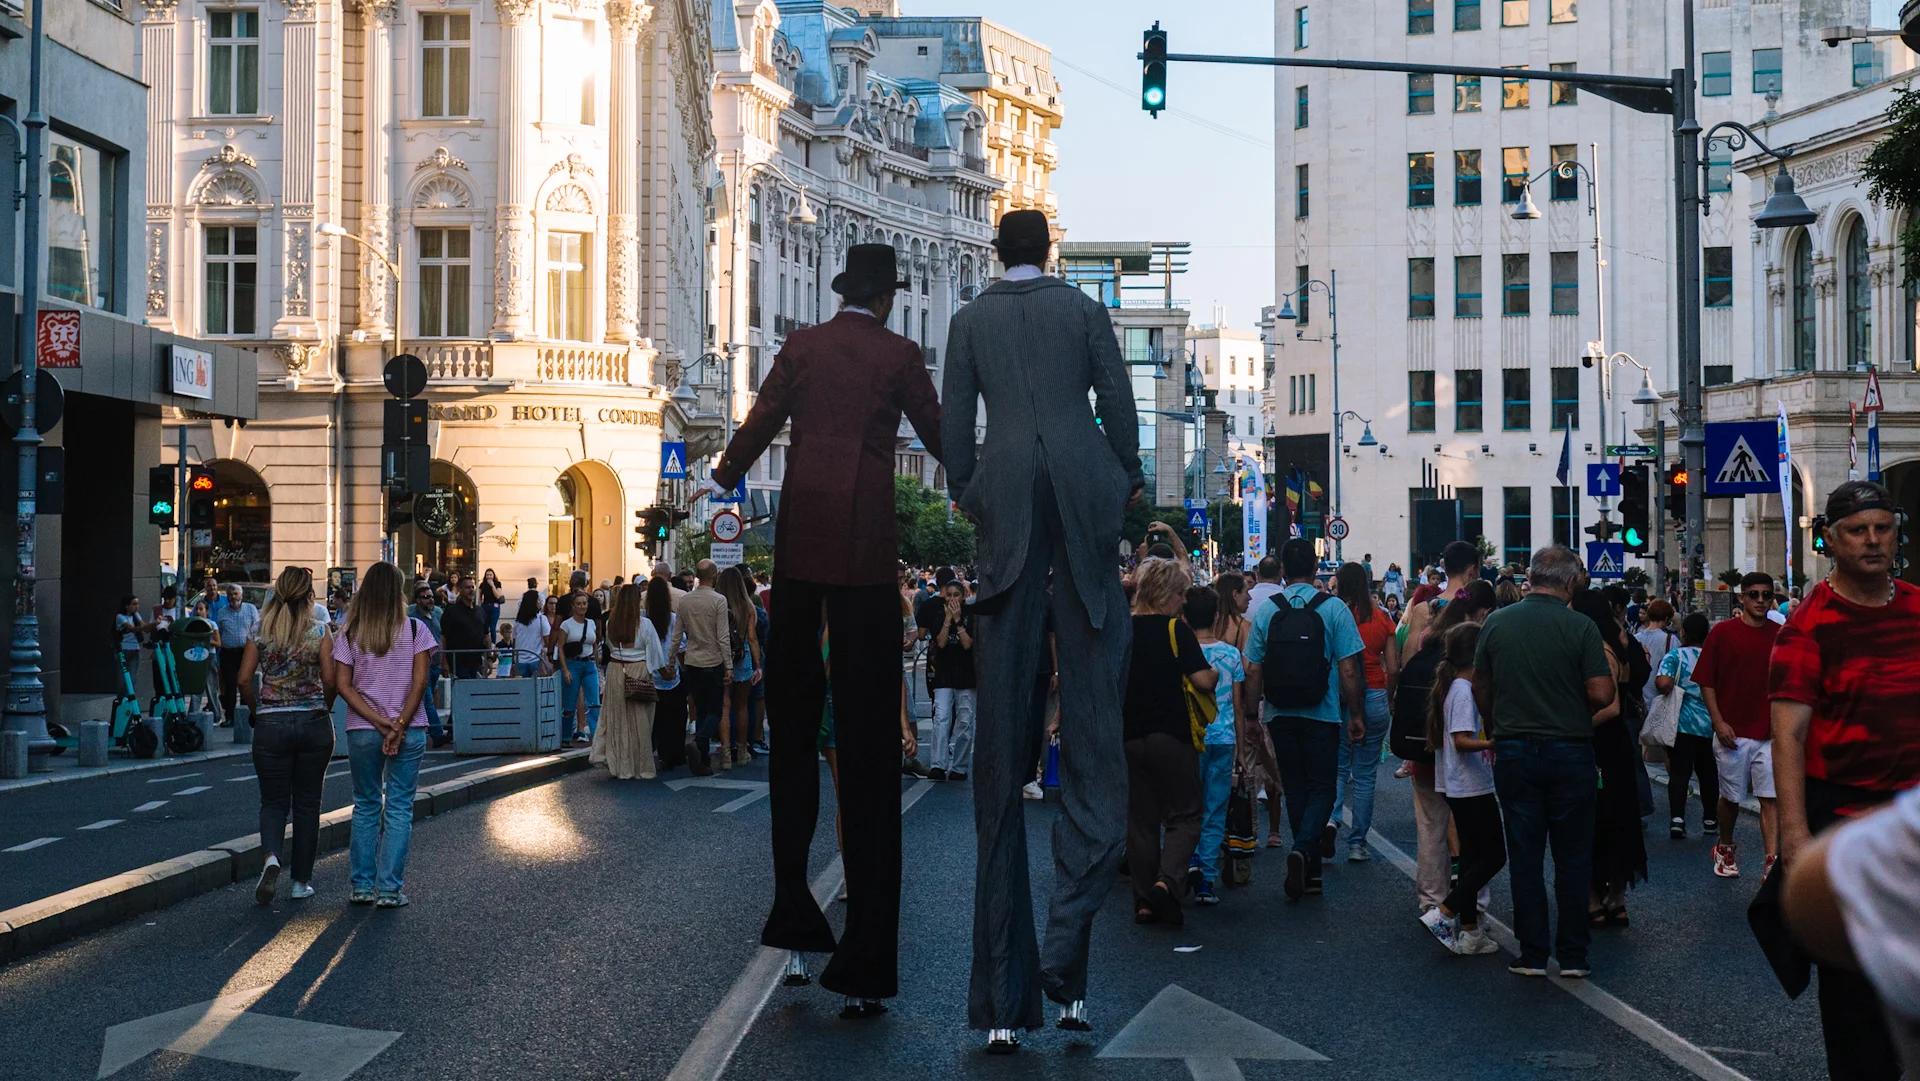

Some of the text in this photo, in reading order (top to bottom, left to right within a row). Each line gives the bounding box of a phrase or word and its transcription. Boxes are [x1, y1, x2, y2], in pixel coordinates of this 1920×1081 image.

[175, 356, 194, 385] ING
[511, 404, 588, 421] HOTEL
[1332, 524, 1344, 535] 30
[211, 547, 246, 563] Spirits
